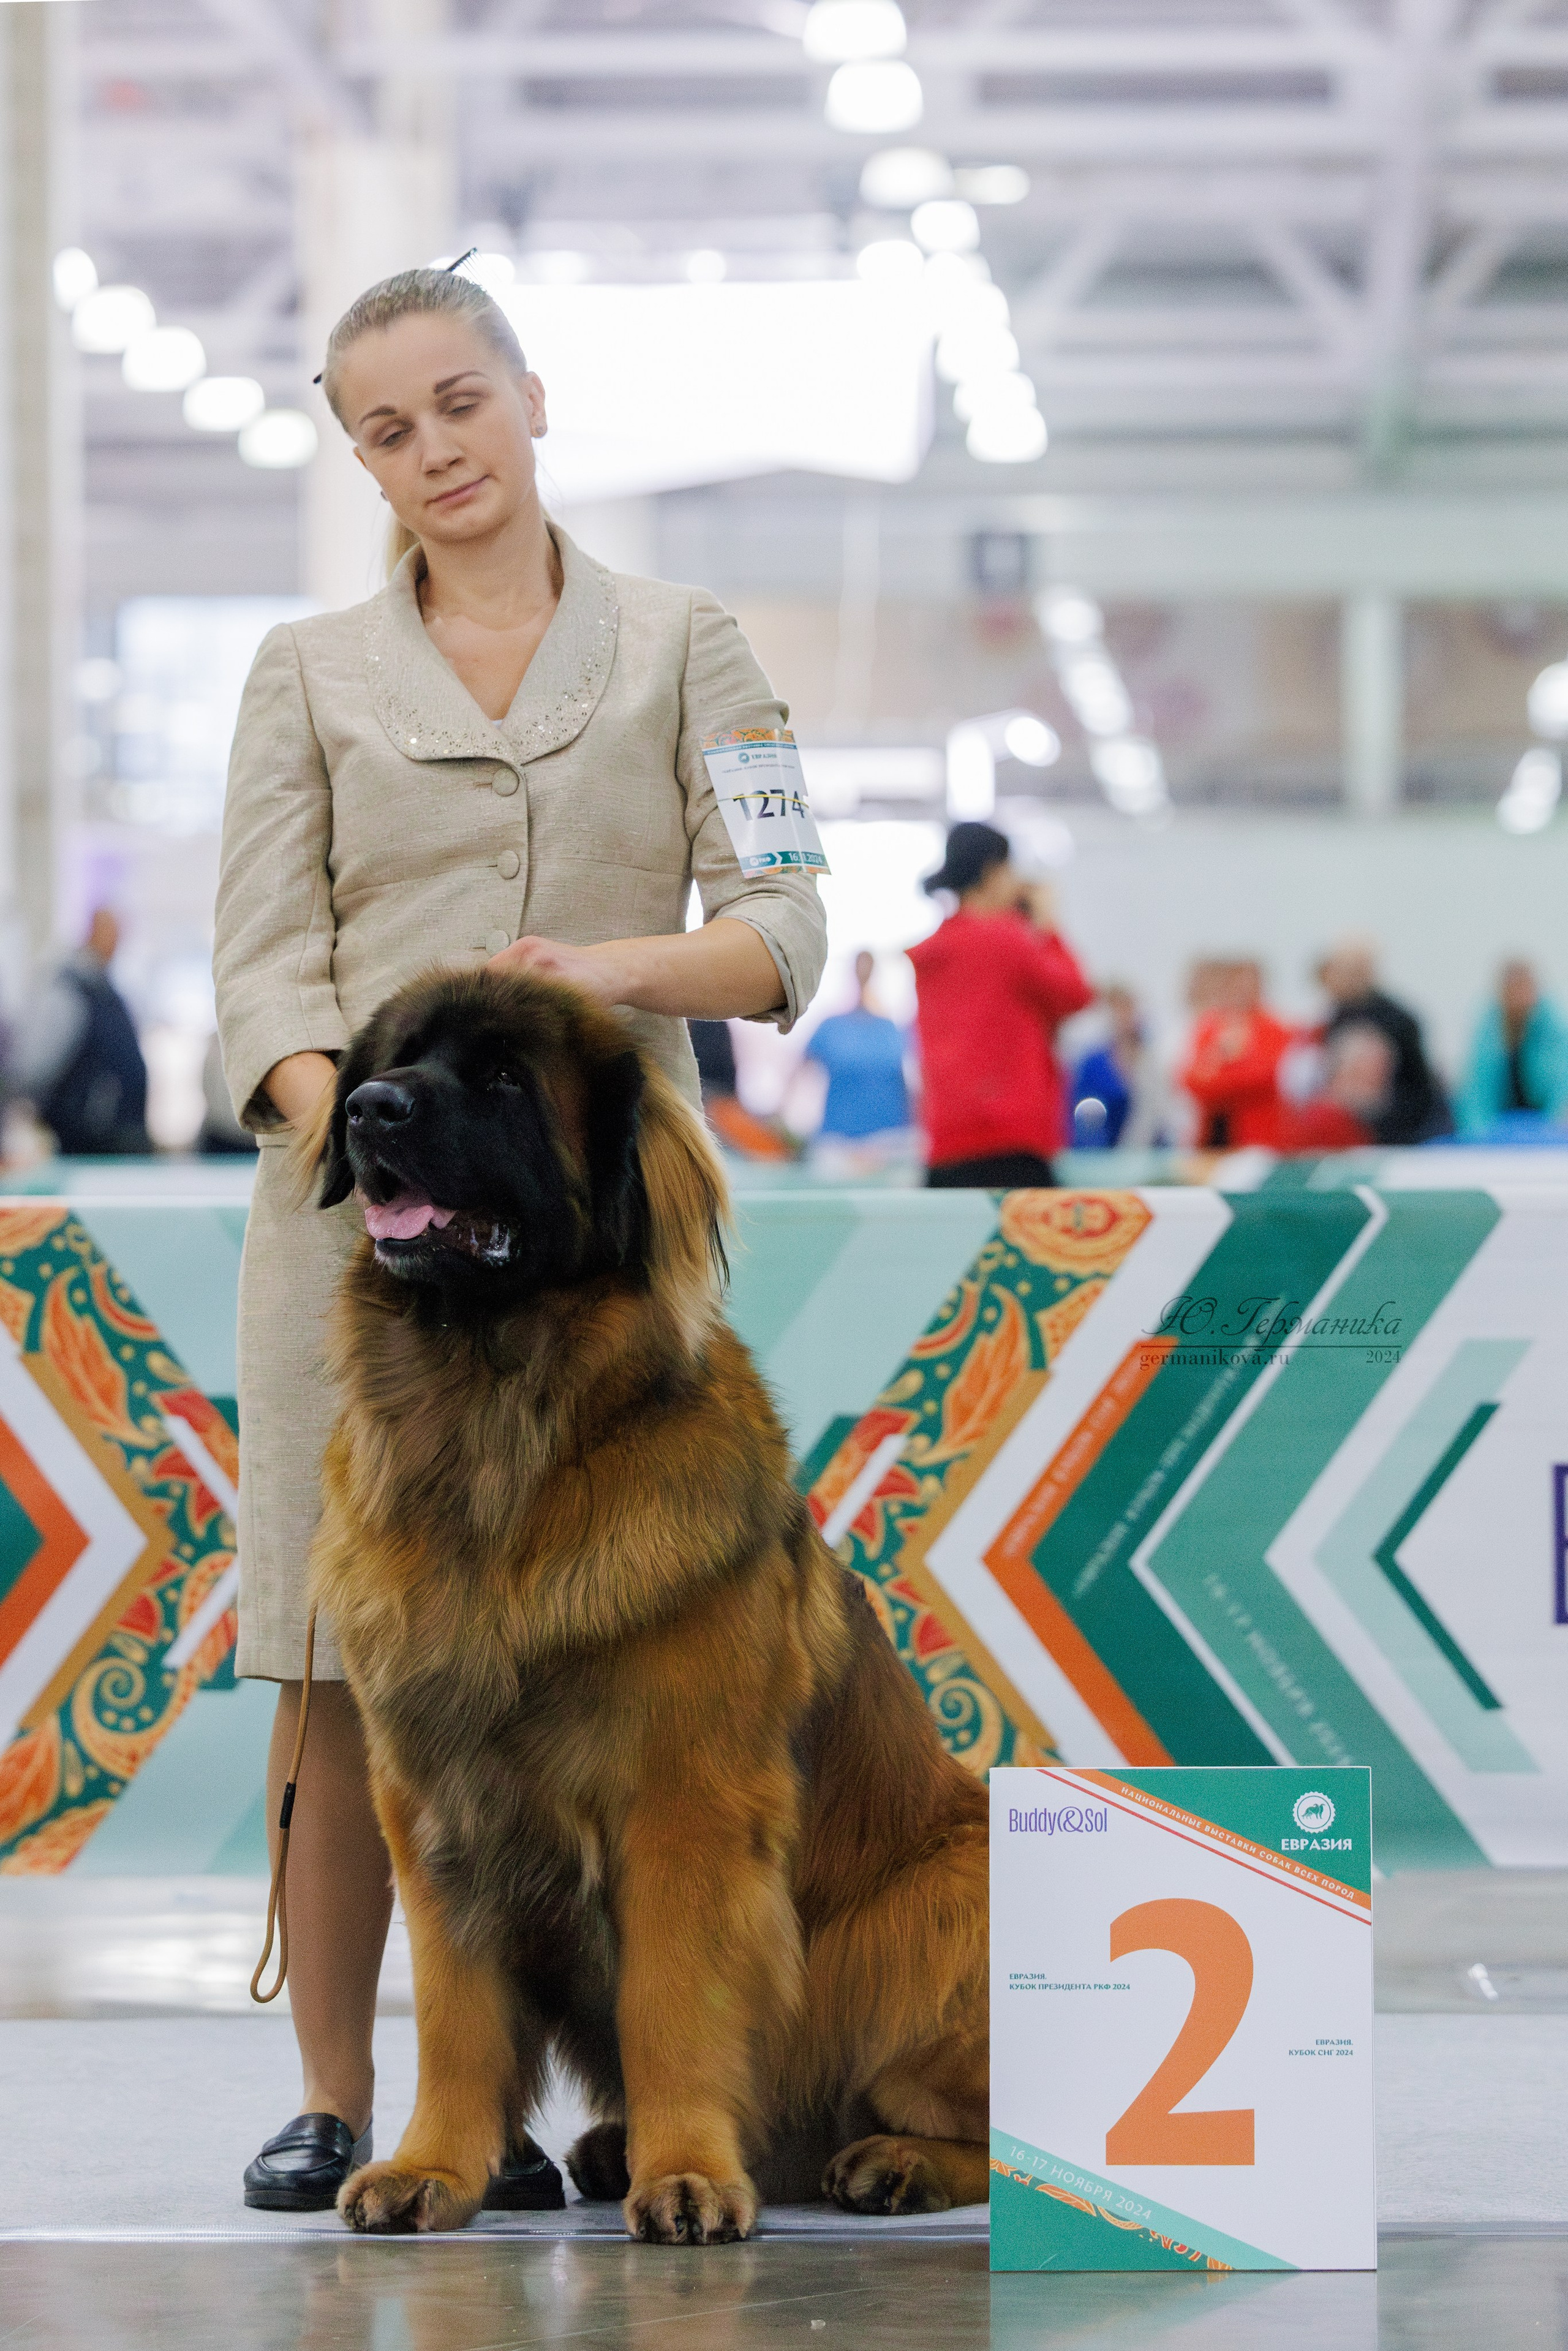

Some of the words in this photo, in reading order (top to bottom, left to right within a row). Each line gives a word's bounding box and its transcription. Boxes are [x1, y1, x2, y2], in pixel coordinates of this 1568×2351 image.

[733, 789, 805, 821] 1274
[1121, 1787, 1202, 1828] НАЦИОНАЛЬНЫЕ
[1204, 1825, 1256, 1854] ВЫСТАВКИ
[1259, 1851, 1291, 1870] СОБАК
[1294, 1866, 1320, 1882] ВСЕХ
[1321, 1879, 1355, 1900] ПОРОД
[1281, 1838, 1352, 1851] ЕВРАЗИЯ
[1105, 1898, 1254, 2165] 2
[1010, 2146, 1047, 2170] 16-17
[1051, 2165, 1113, 2202] НОЯБРЯ
[1115, 2195, 1153, 2219] 2024
